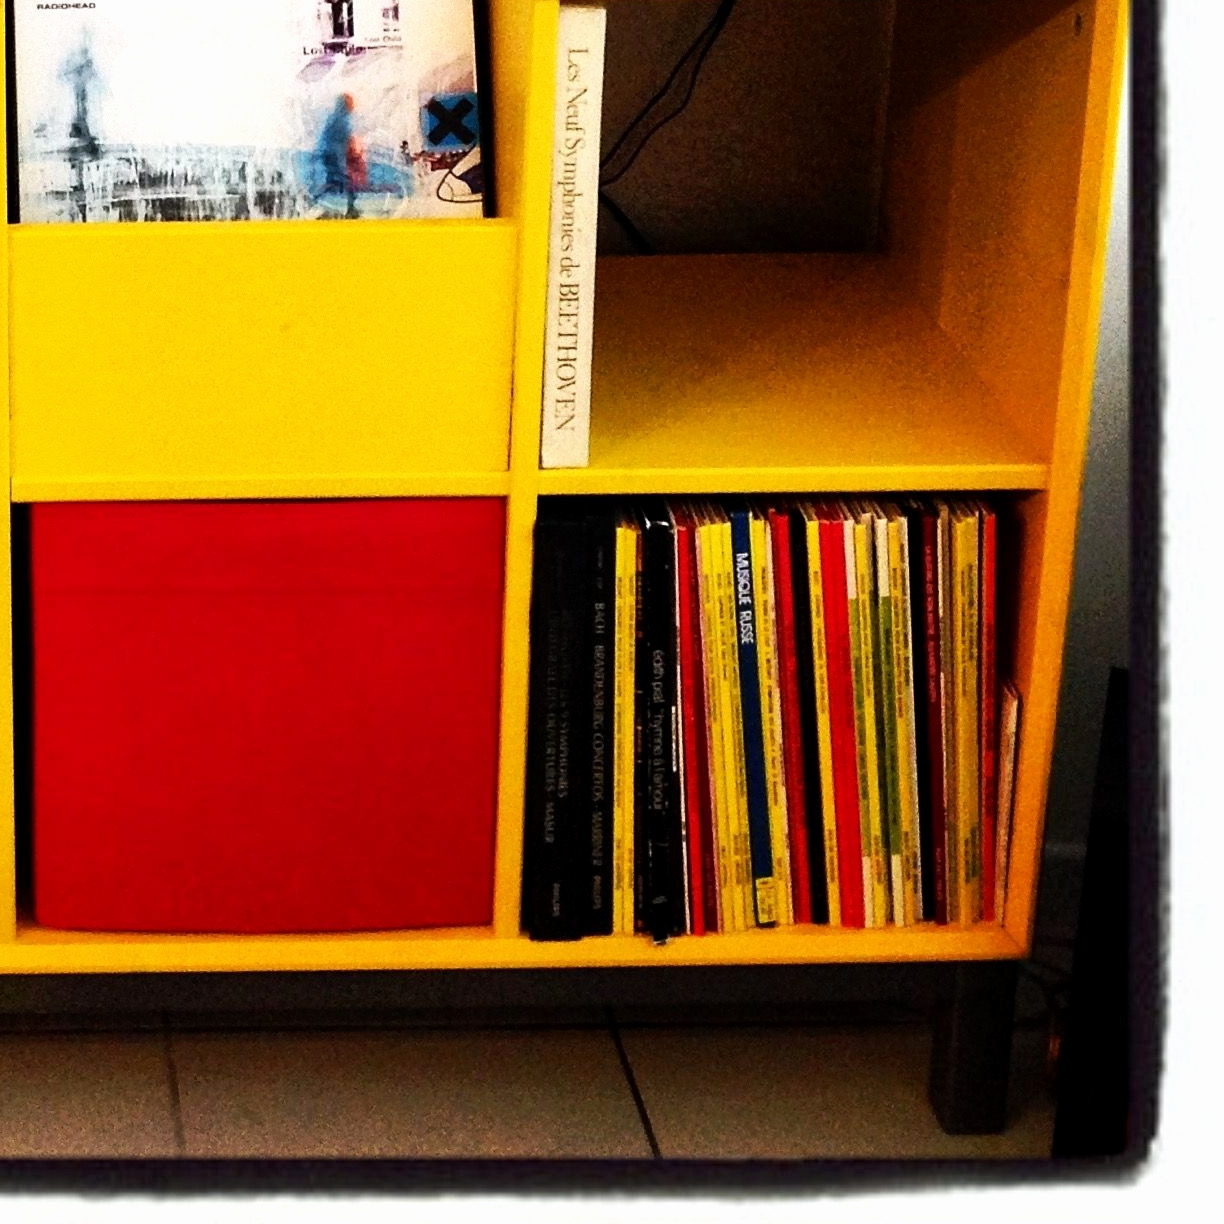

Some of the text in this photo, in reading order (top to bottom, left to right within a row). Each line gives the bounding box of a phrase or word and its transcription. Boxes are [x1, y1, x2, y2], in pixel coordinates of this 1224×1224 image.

[36, 2, 96, 11] RADIOHEAD
[554, 47, 589, 432] Les Neuf Symphonies de BEETHOVEN
[593, 602, 606, 634] BACH
[735, 552, 755, 645] MUSIQUE RUSSE
